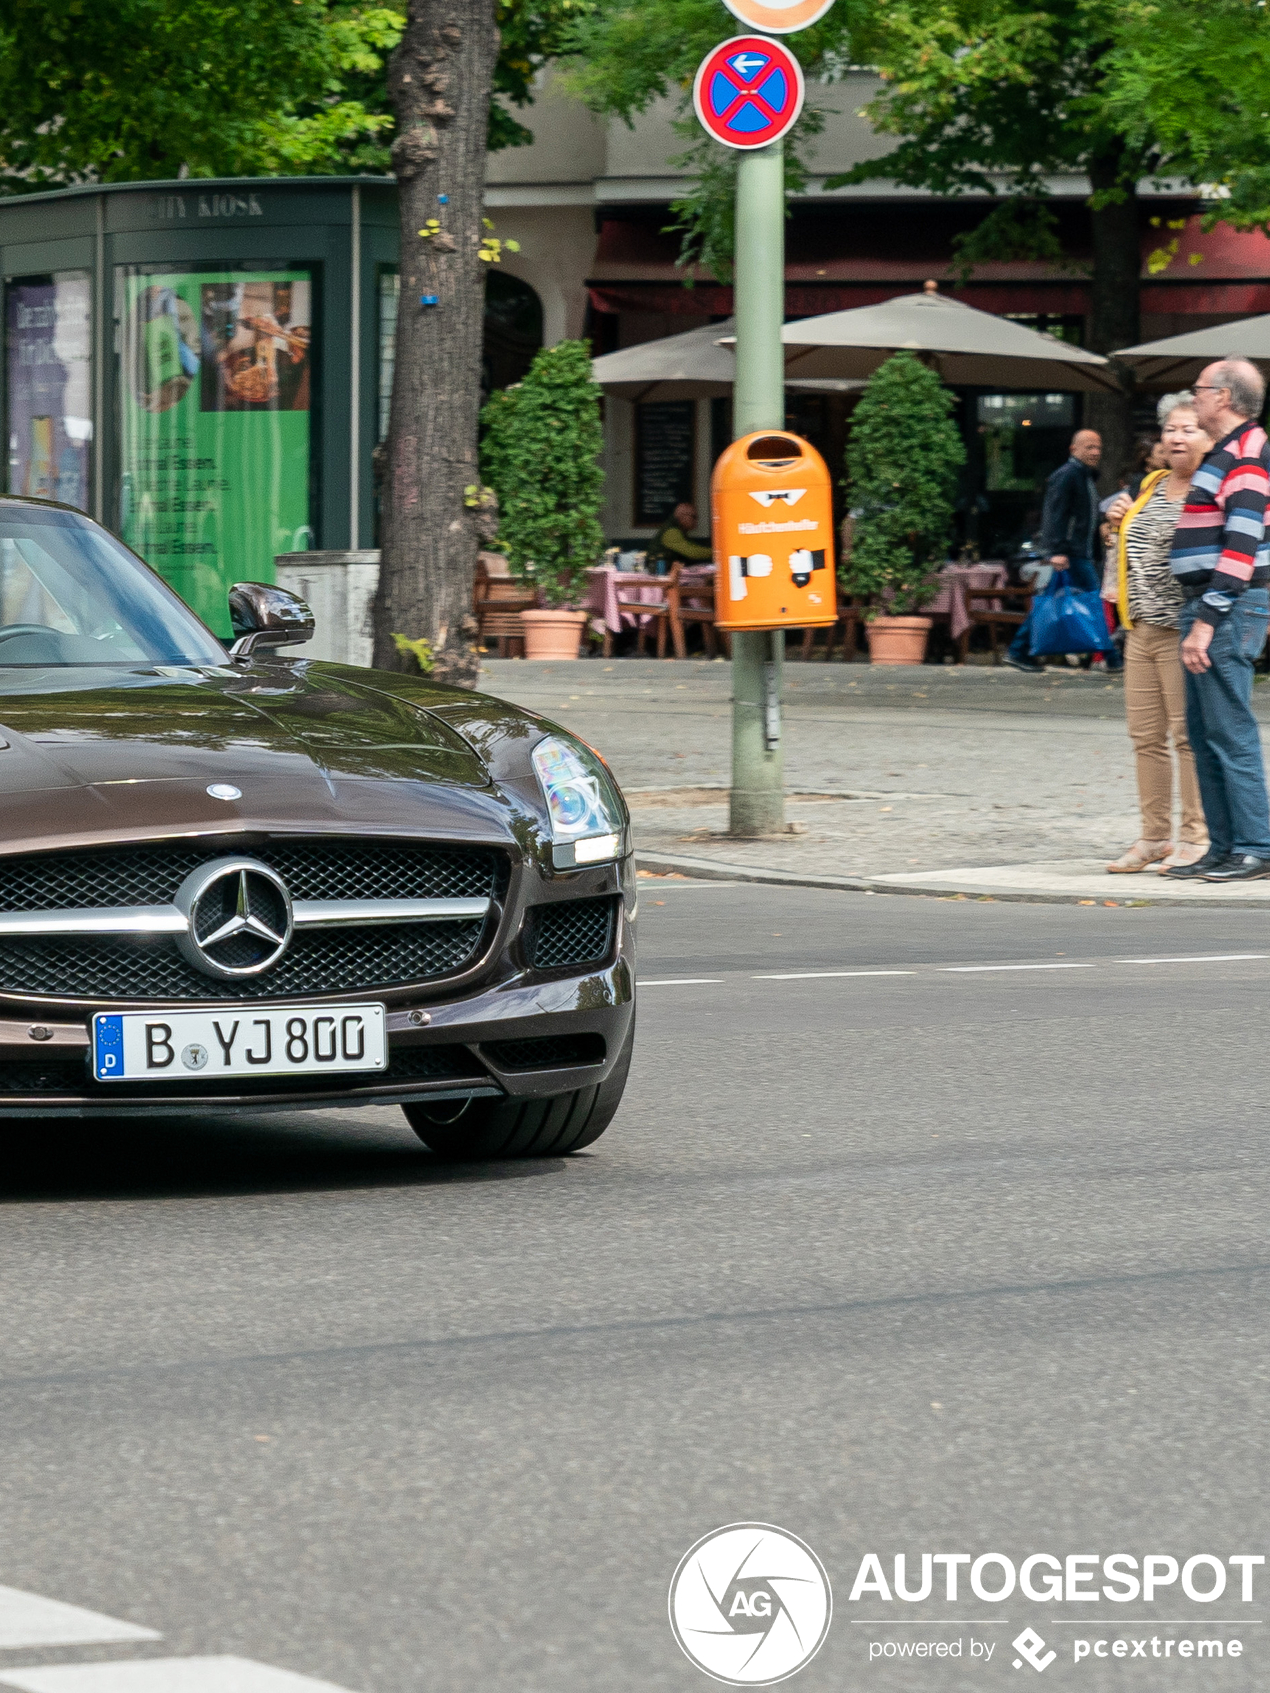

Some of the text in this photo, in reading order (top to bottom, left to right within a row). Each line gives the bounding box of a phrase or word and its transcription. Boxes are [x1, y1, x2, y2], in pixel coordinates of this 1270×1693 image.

[105, 1015, 365, 1069] D B YJ 800
